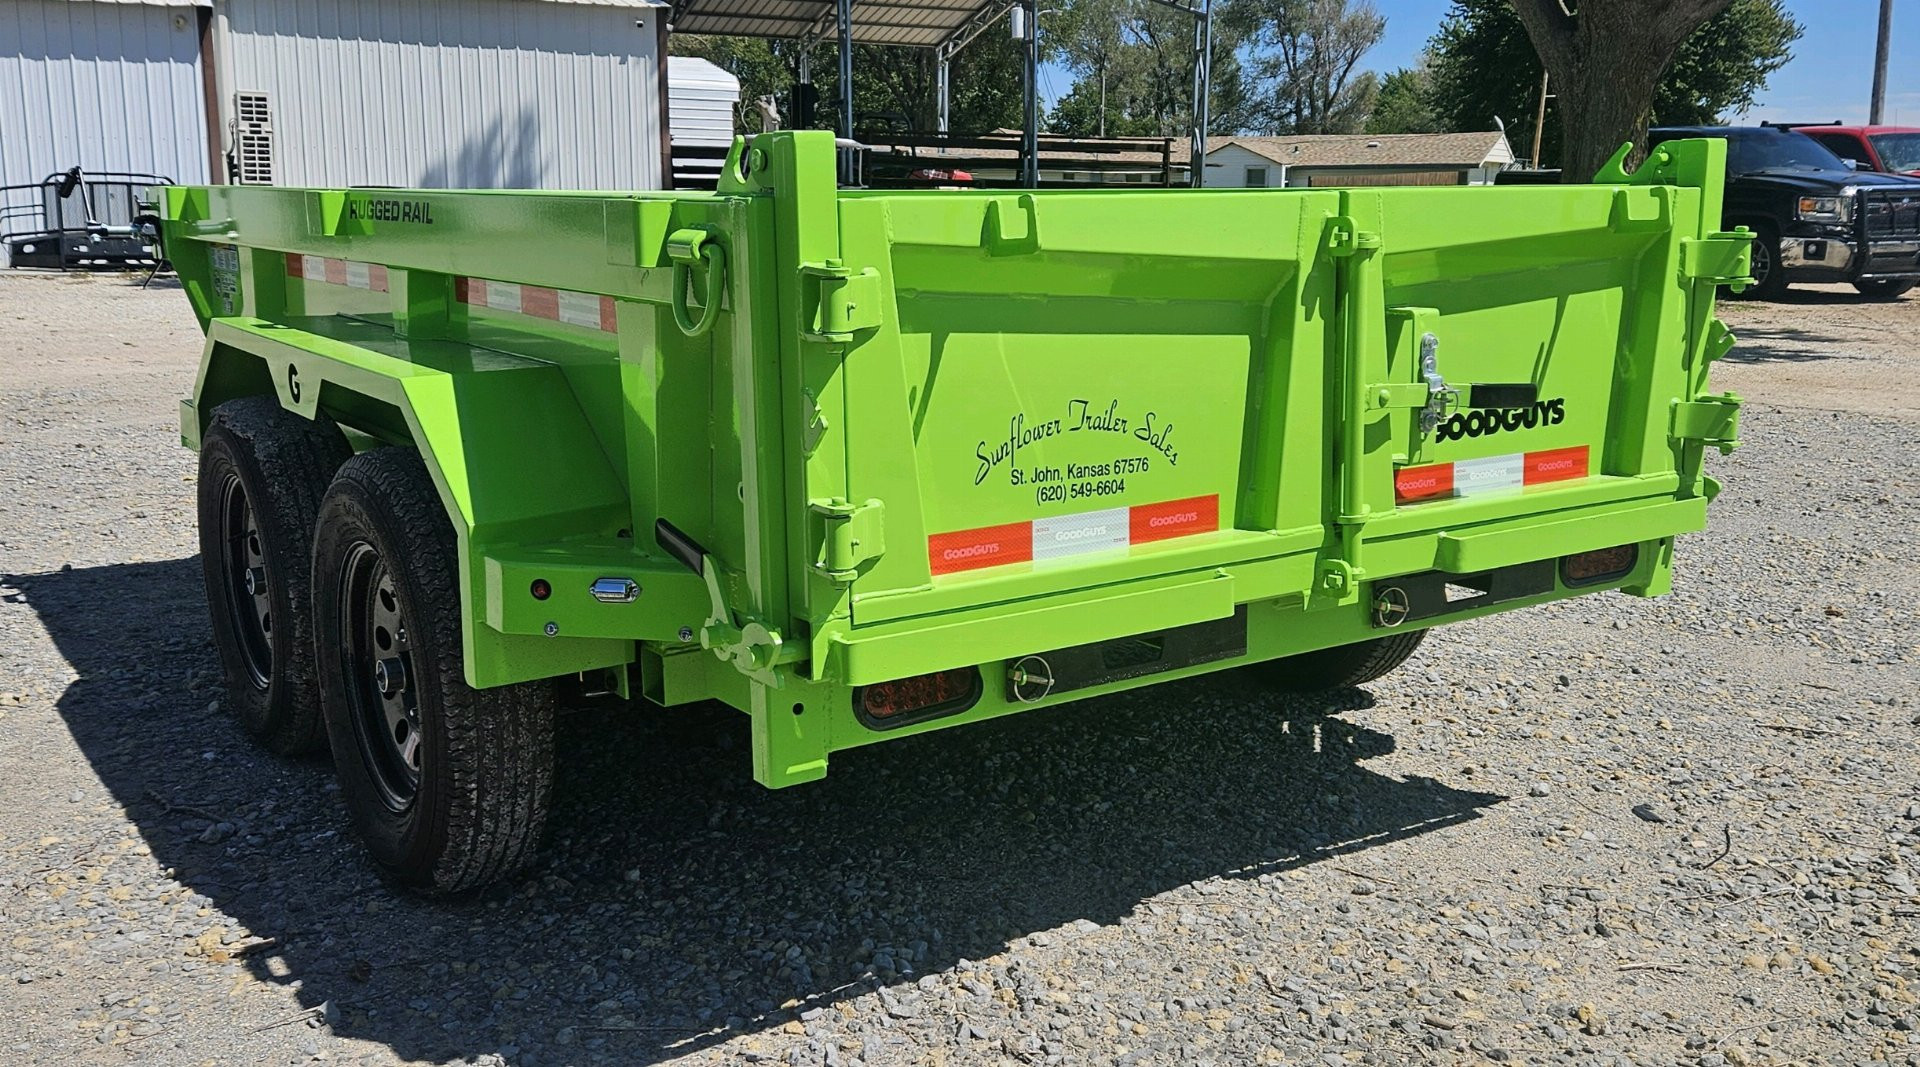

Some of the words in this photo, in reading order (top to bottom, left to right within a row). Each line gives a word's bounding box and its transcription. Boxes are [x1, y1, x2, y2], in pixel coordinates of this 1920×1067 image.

[350, 199, 400, 221] RUGGED
[402, 201, 433, 224] RAIL
[287, 362, 301, 404] G
[974, 413, 1063, 486] Sunflower
[1068, 399, 1128, 434] Trailer
[1133, 412, 1178, 467] Sales
[1010, 468, 1028, 486] St.
[1030, 465, 1063, 485] John,
[1067, 462, 1110, 480] Kansas
[1113, 456, 1149, 474] 67576
[1036, 485, 1067, 506] (620)
[1070, 478, 1125, 499] 549-6604
